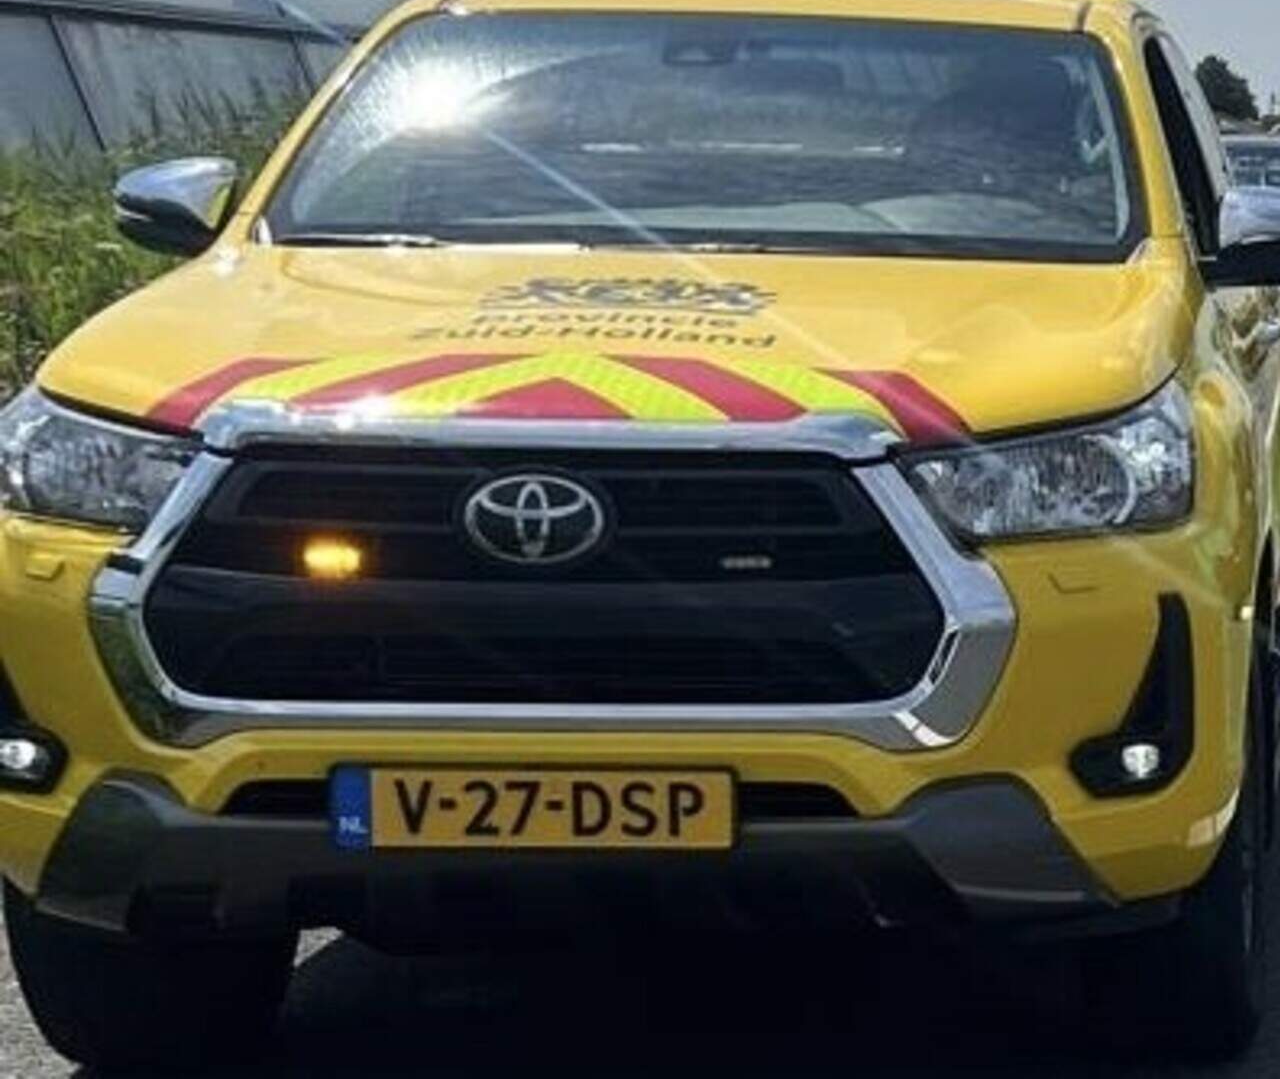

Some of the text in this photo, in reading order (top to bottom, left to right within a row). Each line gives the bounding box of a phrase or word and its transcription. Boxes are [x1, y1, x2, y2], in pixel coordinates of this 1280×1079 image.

[412, 324, 776, 348] Zuid-Holland
[394, 779, 704, 837] V-27-DSP
[339, 817, 367, 834] NL
